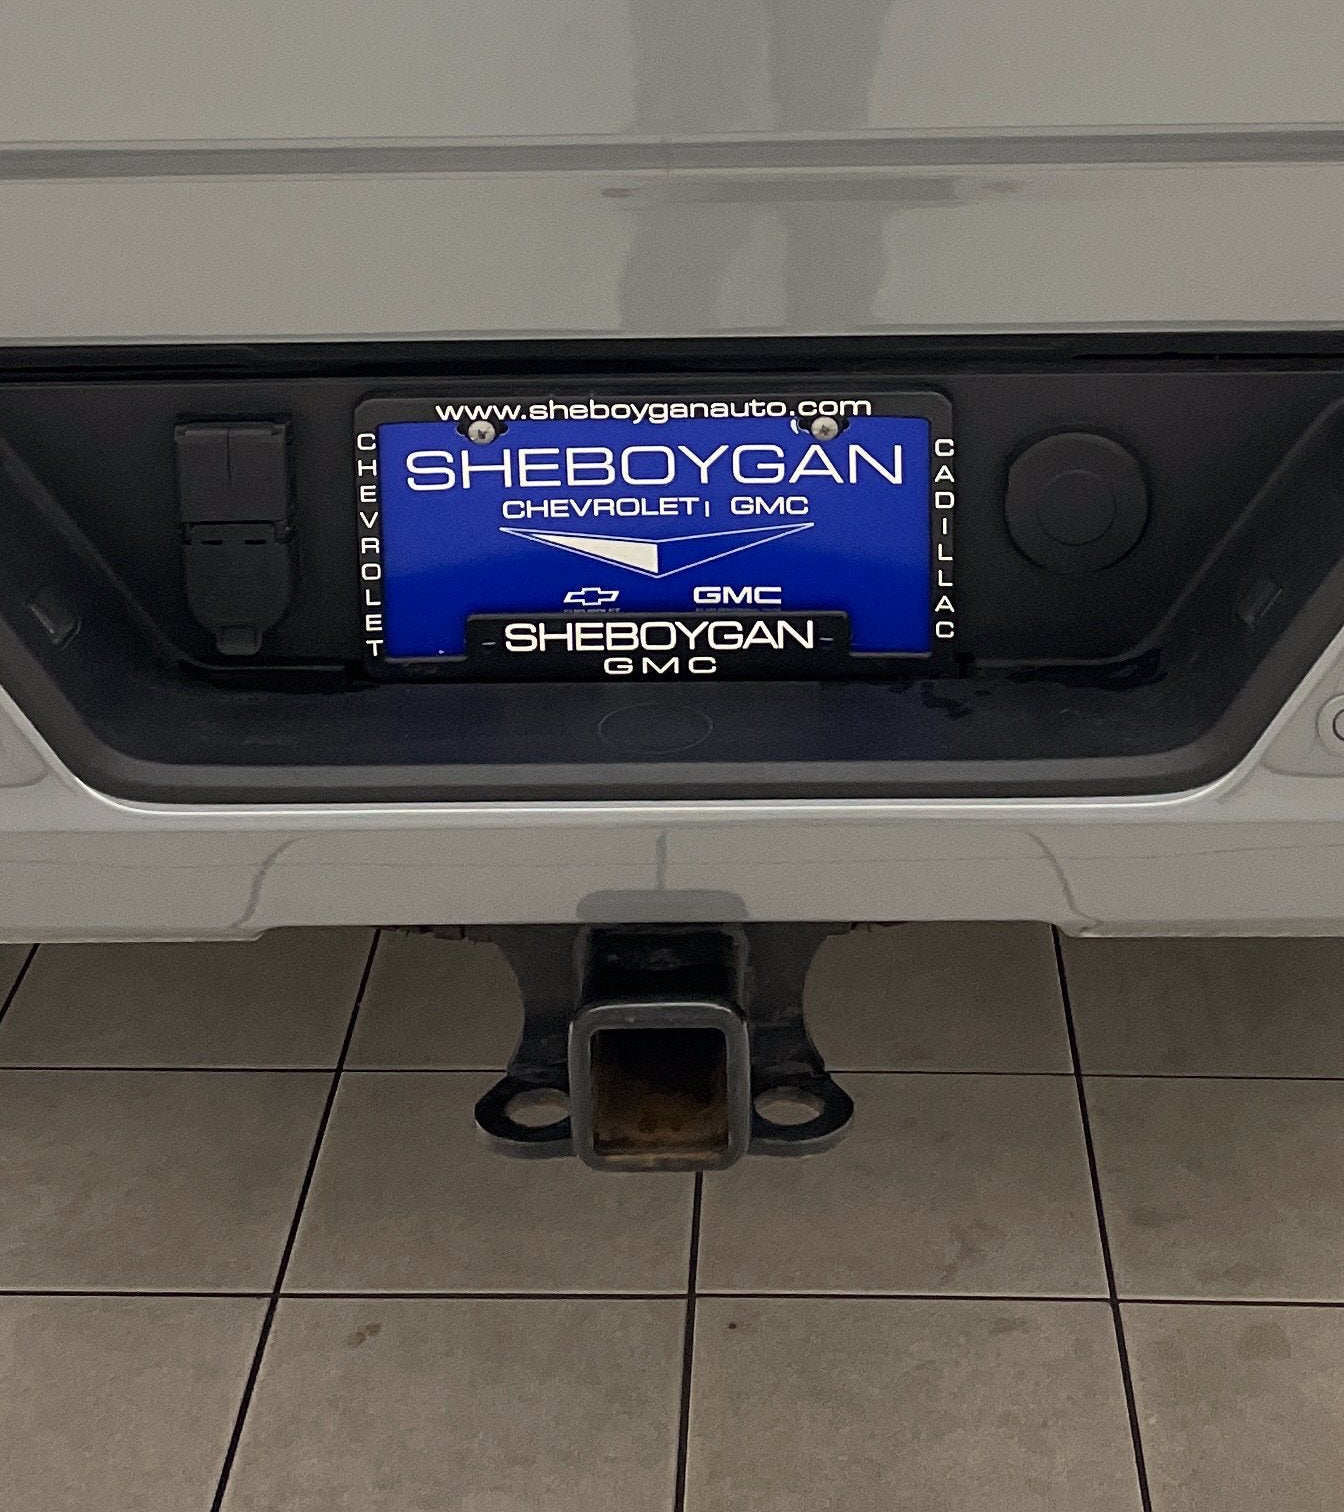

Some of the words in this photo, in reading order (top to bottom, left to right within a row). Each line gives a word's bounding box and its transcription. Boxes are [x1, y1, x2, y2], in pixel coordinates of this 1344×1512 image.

[435, 397, 873, 424] www.sheboyganauto.com
[405, 443, 904, 491] SHEBOYGAN
[502, 498, 698, 520] CHEVROLET
[730, 495, 810, 517] GMC
[357, 432, 384, 658] CHEVROLET
[934, 438, 956, 639] CADILLAC
[693, 586, 782, 605] GMC
[505, 619, 814, 653] SHEBOYGAN
[603, 656, 717, 675] GMC
